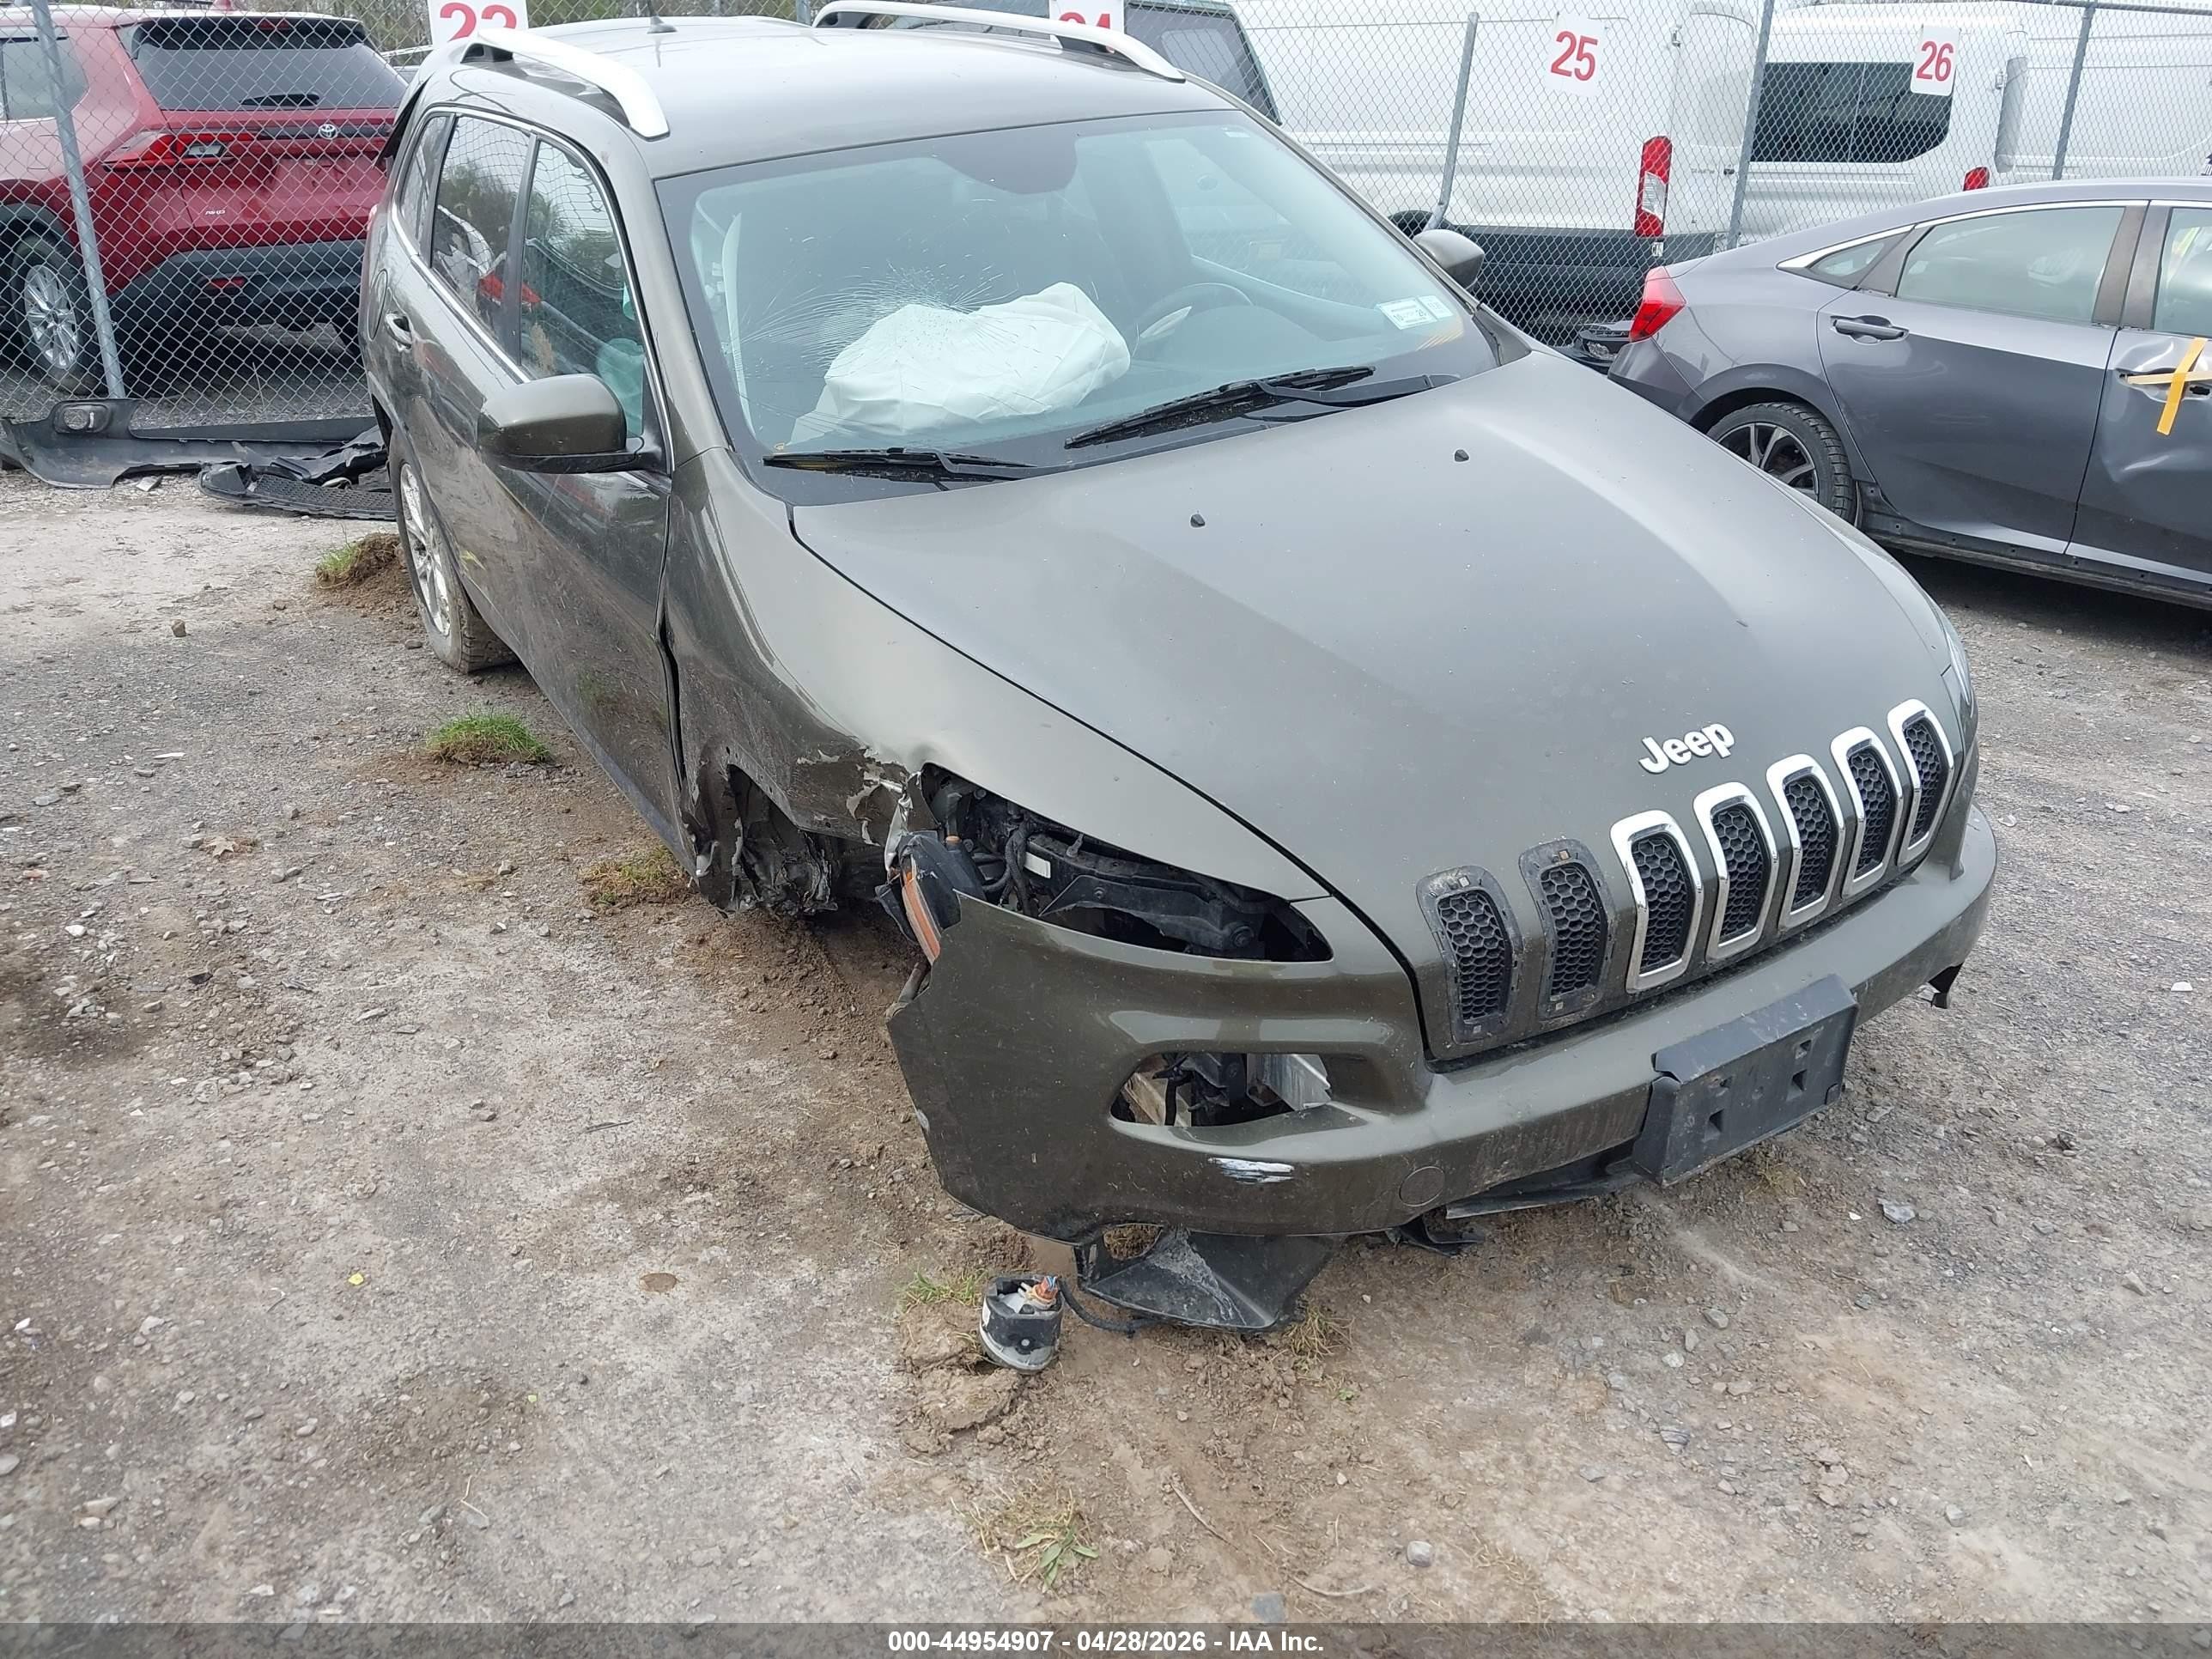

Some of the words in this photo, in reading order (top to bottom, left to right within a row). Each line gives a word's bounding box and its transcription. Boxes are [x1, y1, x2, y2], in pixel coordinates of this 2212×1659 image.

[1551, 30, 1598, 82] 25
[1916, 40, 1954, 82] 26
[1638, 723, 1735, 775] Jeep
